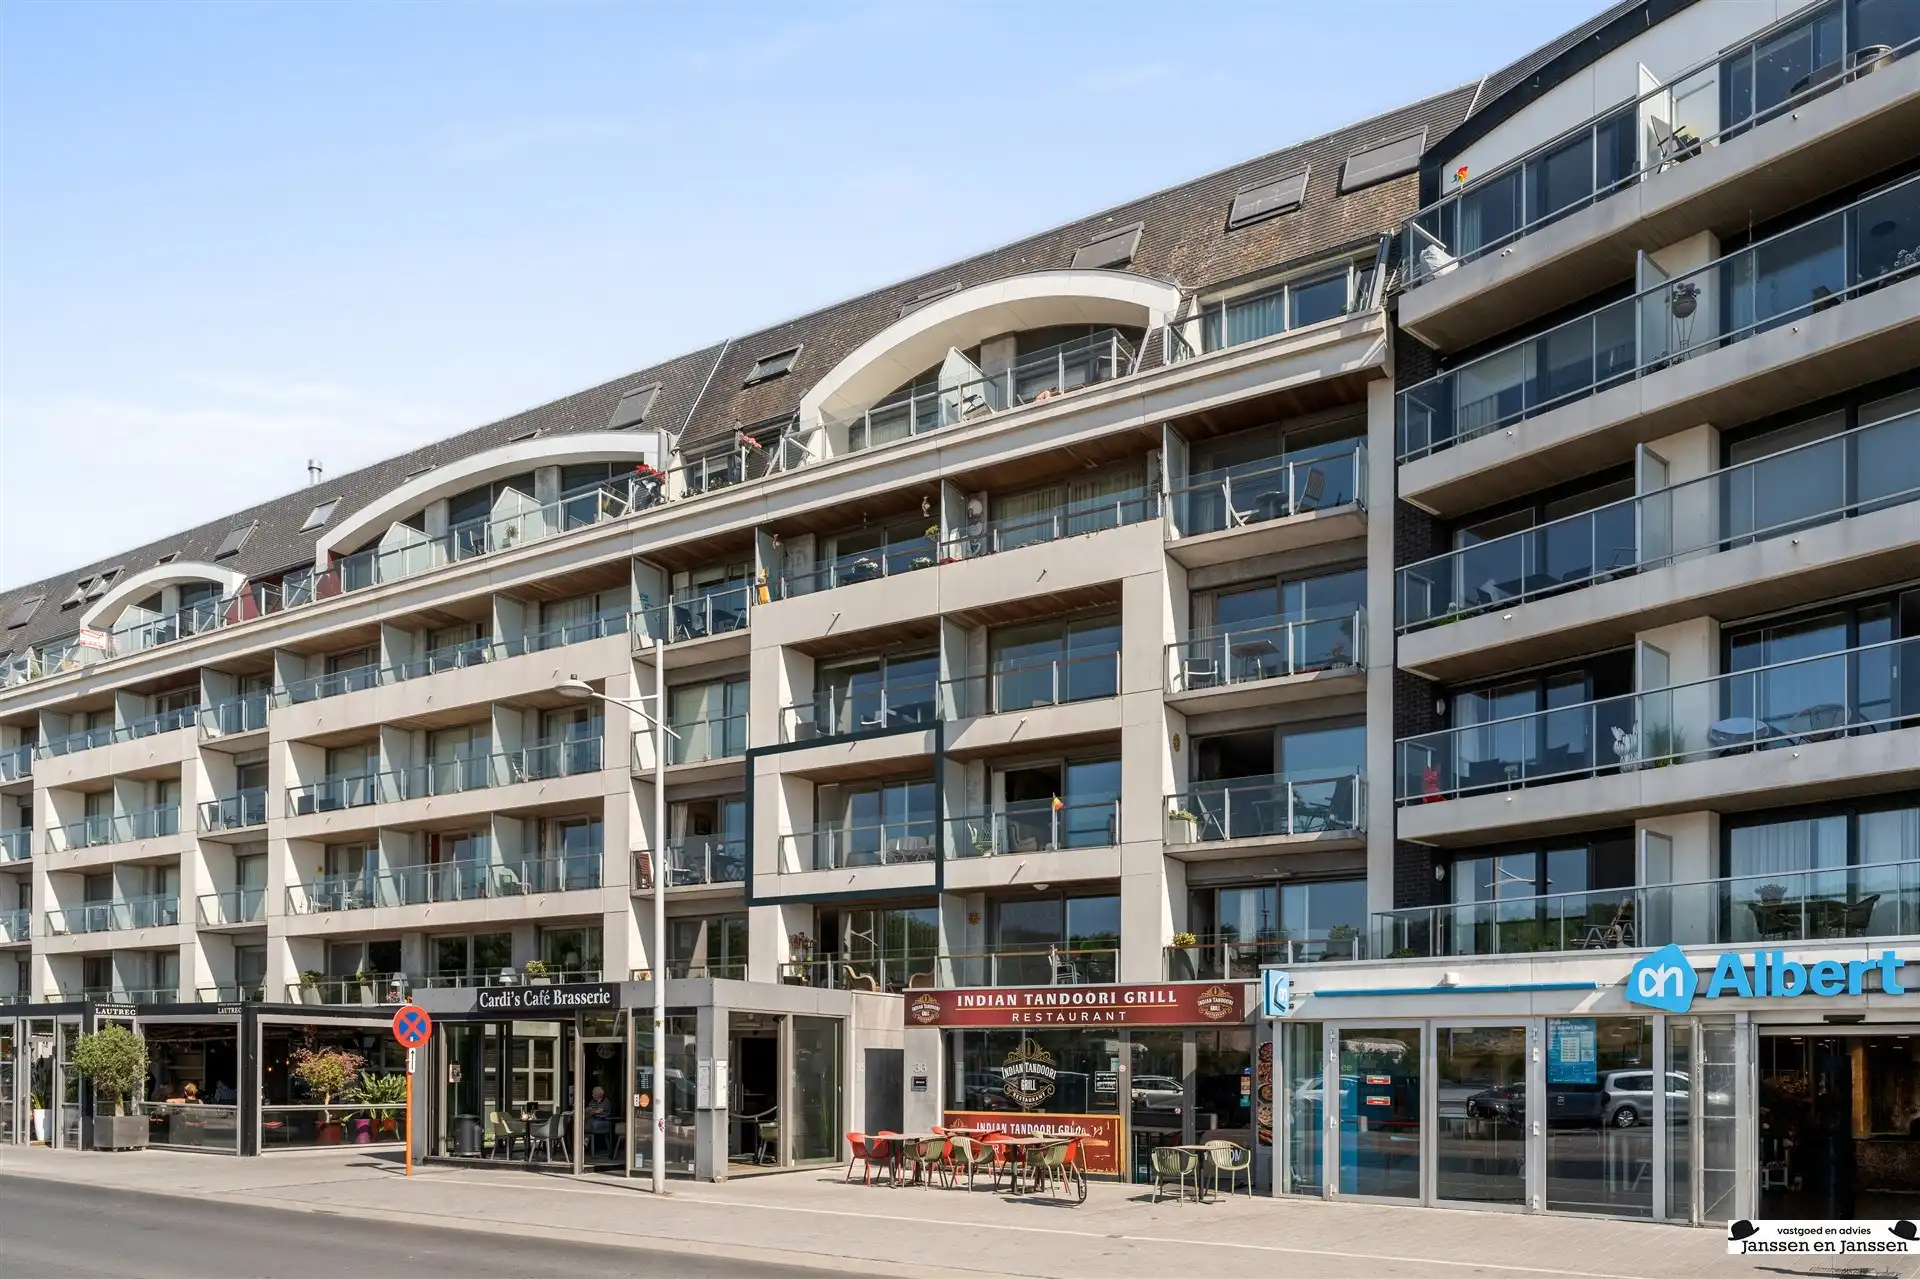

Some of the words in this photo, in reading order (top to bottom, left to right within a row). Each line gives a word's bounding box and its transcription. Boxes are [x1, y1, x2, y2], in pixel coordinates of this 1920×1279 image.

[1705, 950, 1905, 999] Albert
[480, 991, 521, 1008] Cardi's
[523, 989, 551, 1006] Café
[553, 987, 611, 1005] Brasserie
[957, 994, 1017, 1007] INDIAN
[1024, 991, 1116, 1006] TANDOORI
[1124, 990, 1177, 1004] GRILL
[95, 1007, 136, 1016] LAUTREC
[217, 1006, 243, 1014] LAUTREC
[1012, 1011, 1127, 1022] RESTAURANT
[1001, 1063, 1024, 1080] INDIAN
[1024, 1062, 1057, 1080] TANDOORI
[1020, 1079, 1037, 1091] GRILL
